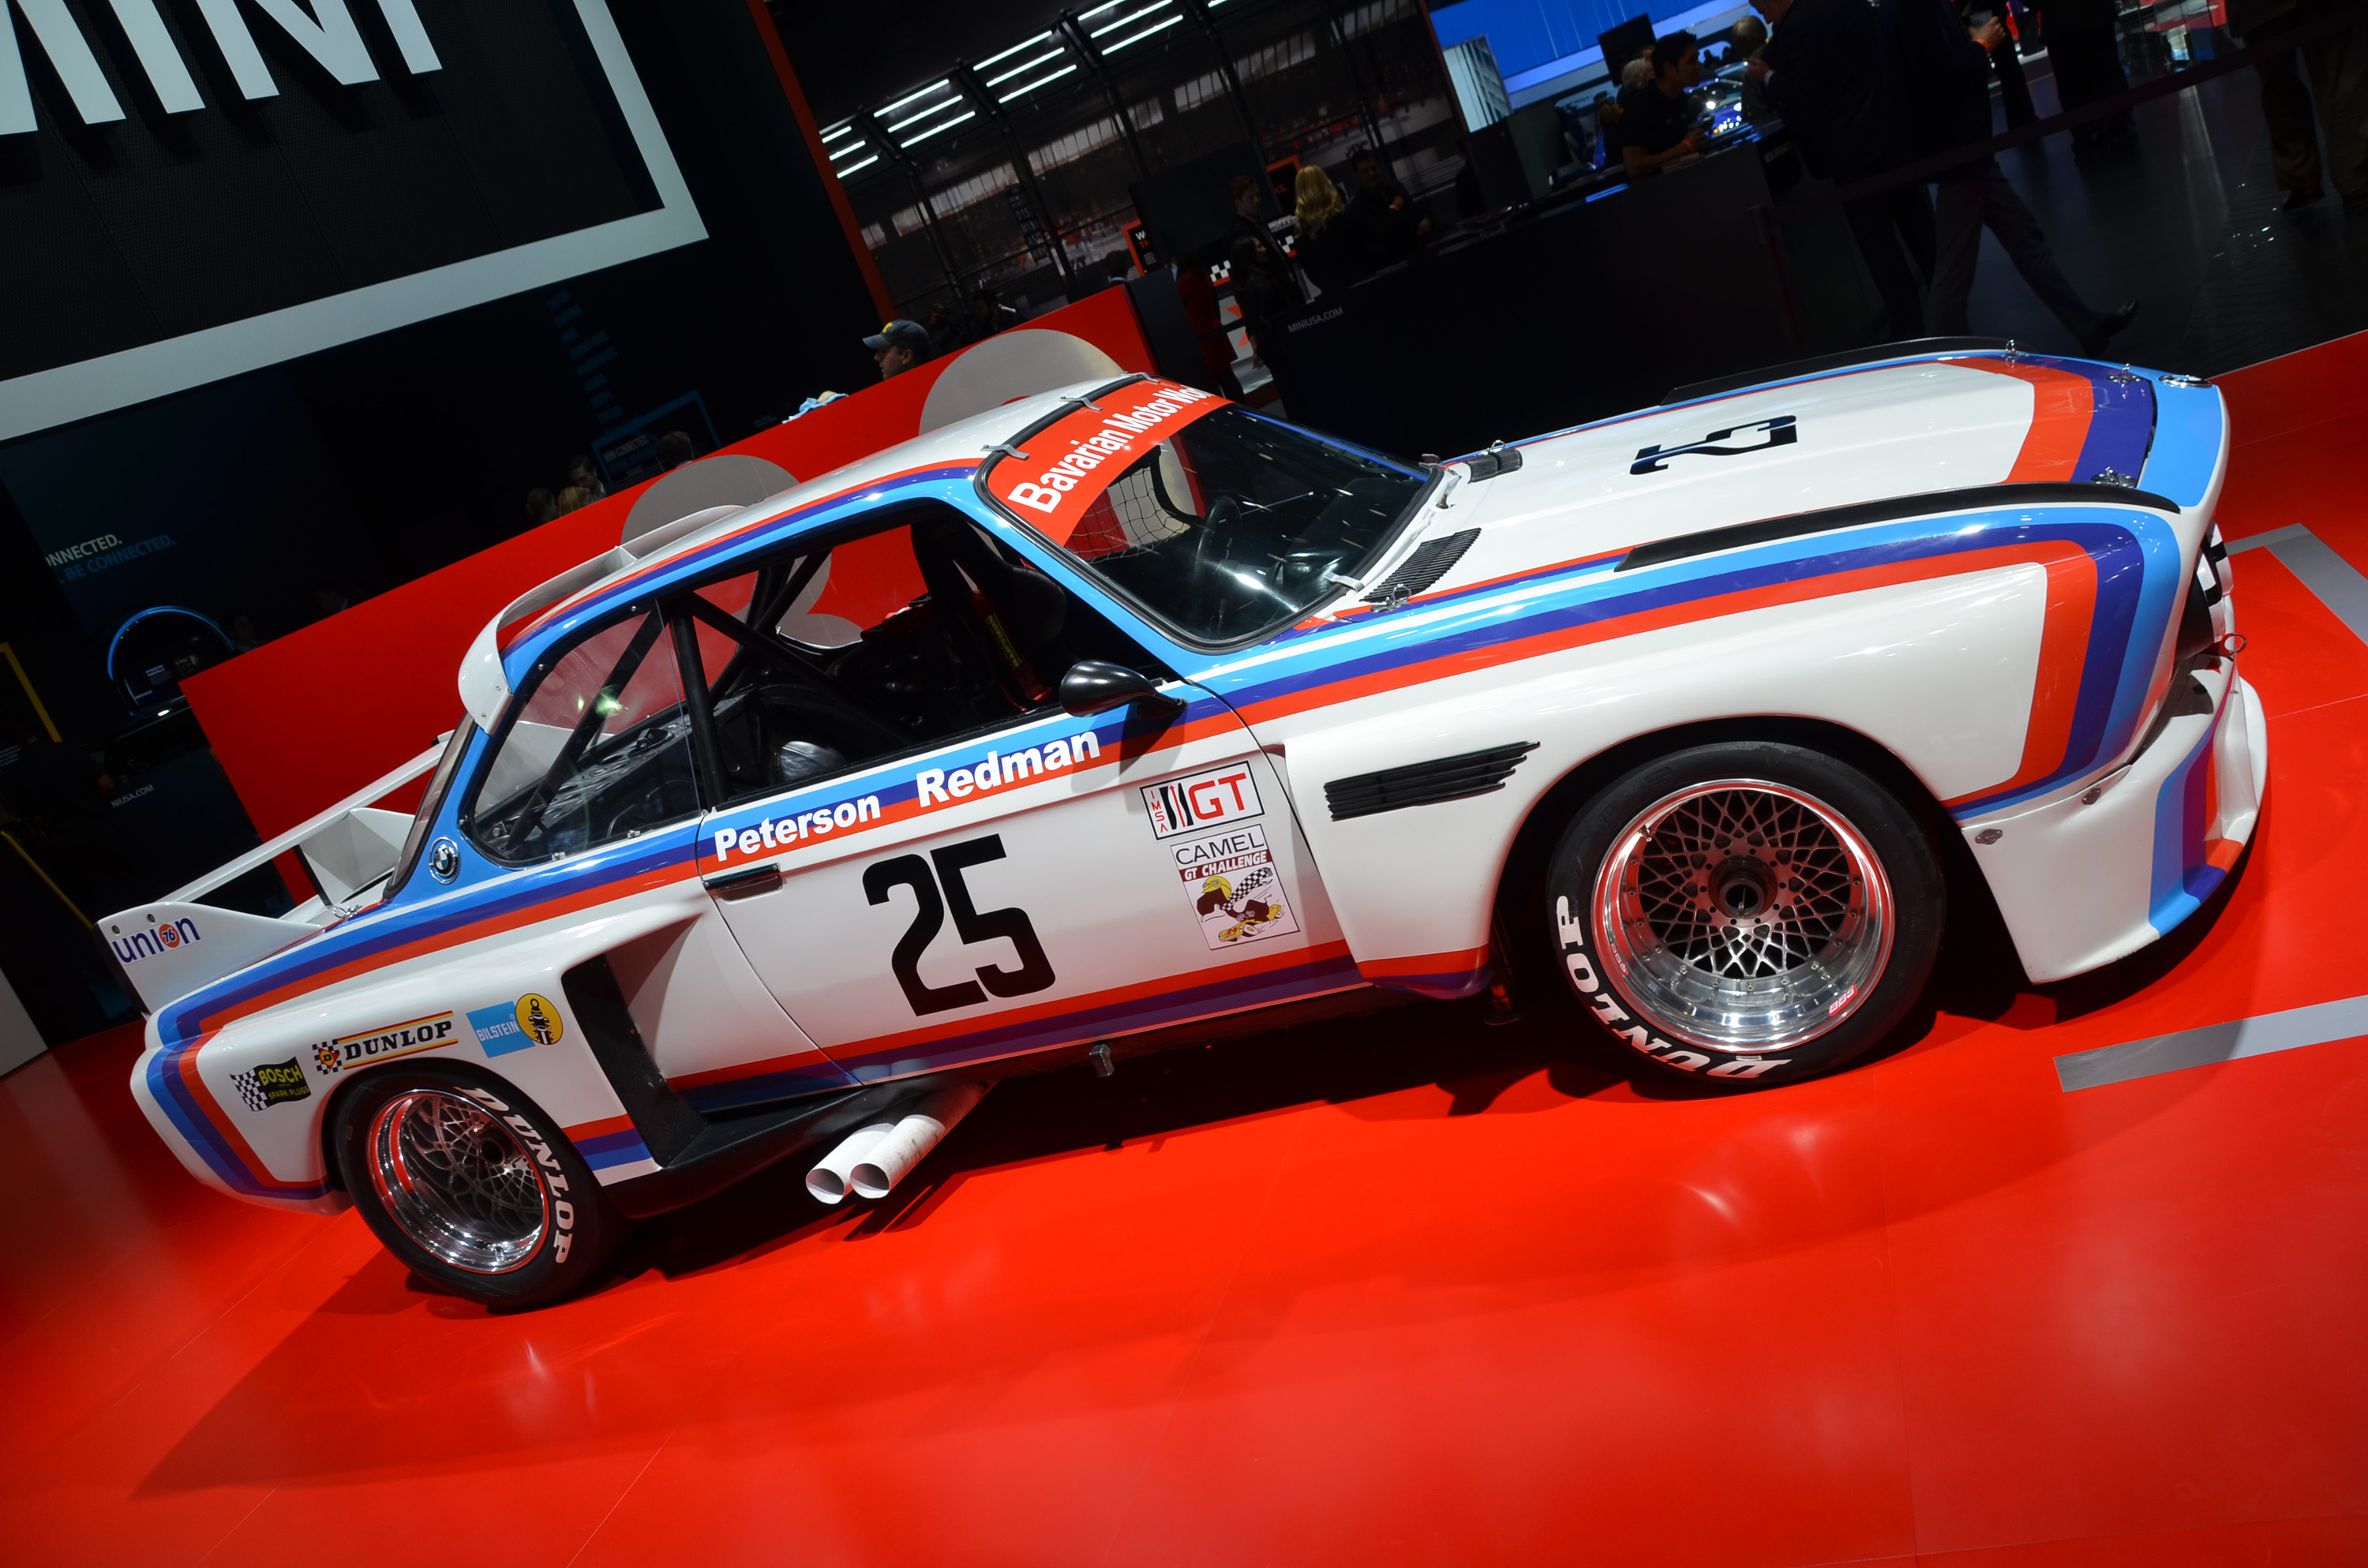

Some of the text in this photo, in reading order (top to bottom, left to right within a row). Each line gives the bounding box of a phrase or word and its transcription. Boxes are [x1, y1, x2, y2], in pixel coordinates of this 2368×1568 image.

[1287, 307, 1344, 334] MINIUSA.COM
[1007, 428, 1130, 514] Bavarian
[1102, 398, 1183, 434] Motor
[63, 533, 176, 582] BE CONNECTED.
[714, 731, 1101, 863] Peterson Redman
[1188, 773, 1247, 821] GT
[1175, 833, 1265, 865] CAMEL
[1184, 851, 1267, 881] GT CHALLENGE
[163, 927, 176, 944] 76
[862, 833, 1056, 1016] 25
[1556, 895, 1792, 1079] DUNLOP
[344, 1020, 452, 1061] DUNLOP
[476, 1020, 521, 1042] BILSTEIN
[257, 1064, 303, 1087] BOSCH
[268, 1088, 289, 1101] SPARK
[288, 1085, 310, 1097] PLUGS
[453, 1086, 574, 1263] DUNLOP
